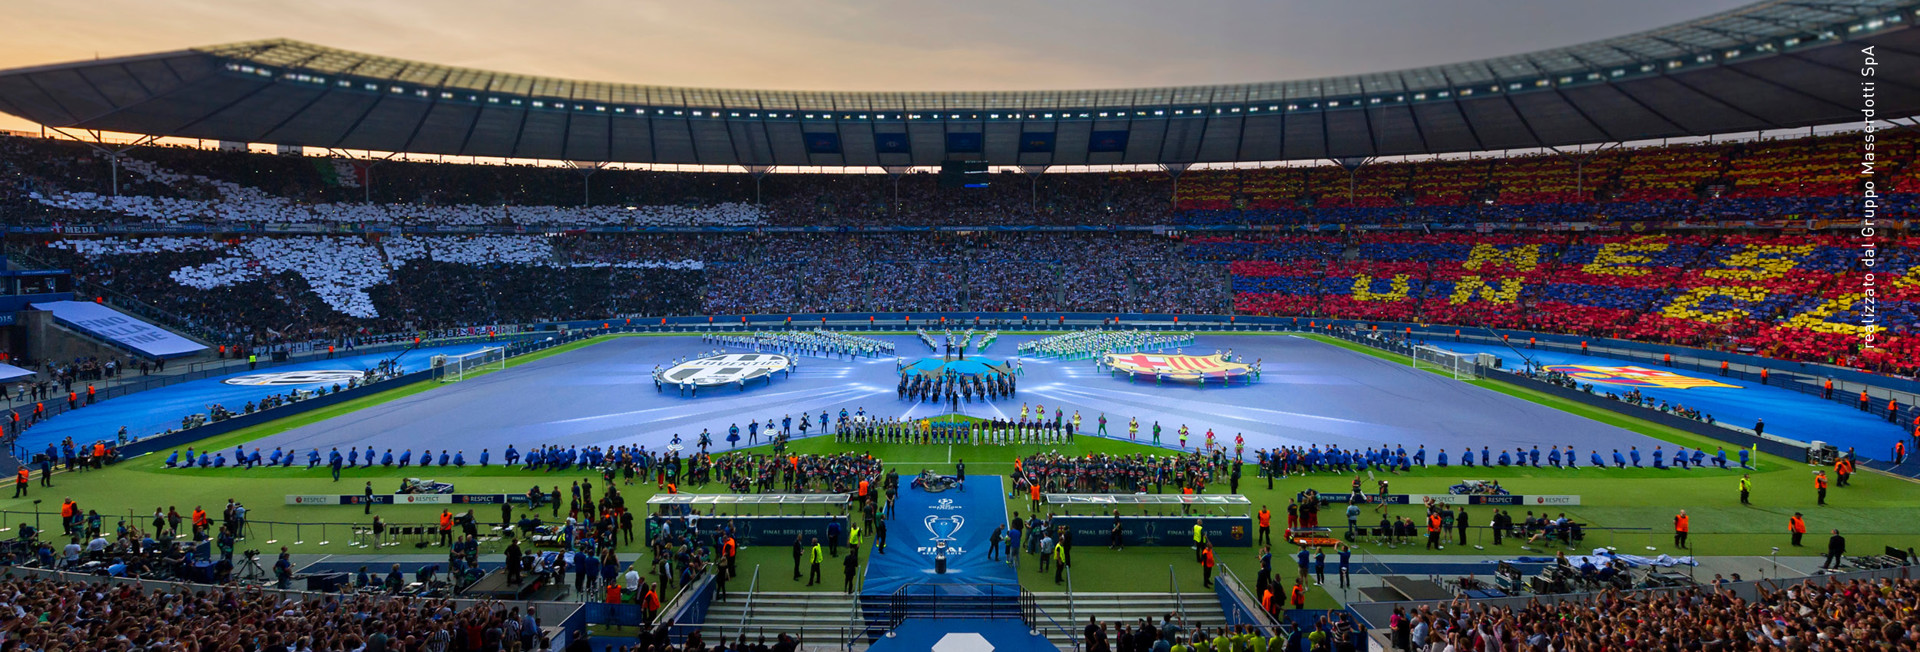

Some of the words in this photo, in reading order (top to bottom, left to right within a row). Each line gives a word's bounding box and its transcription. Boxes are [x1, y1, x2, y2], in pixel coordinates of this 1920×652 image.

[65, 226, 96, 234] MEDA
[77, 316, 129, 329] FINO
[98, 323, 151, 337] ALLA
[117, 331, 169, 345] FINE
